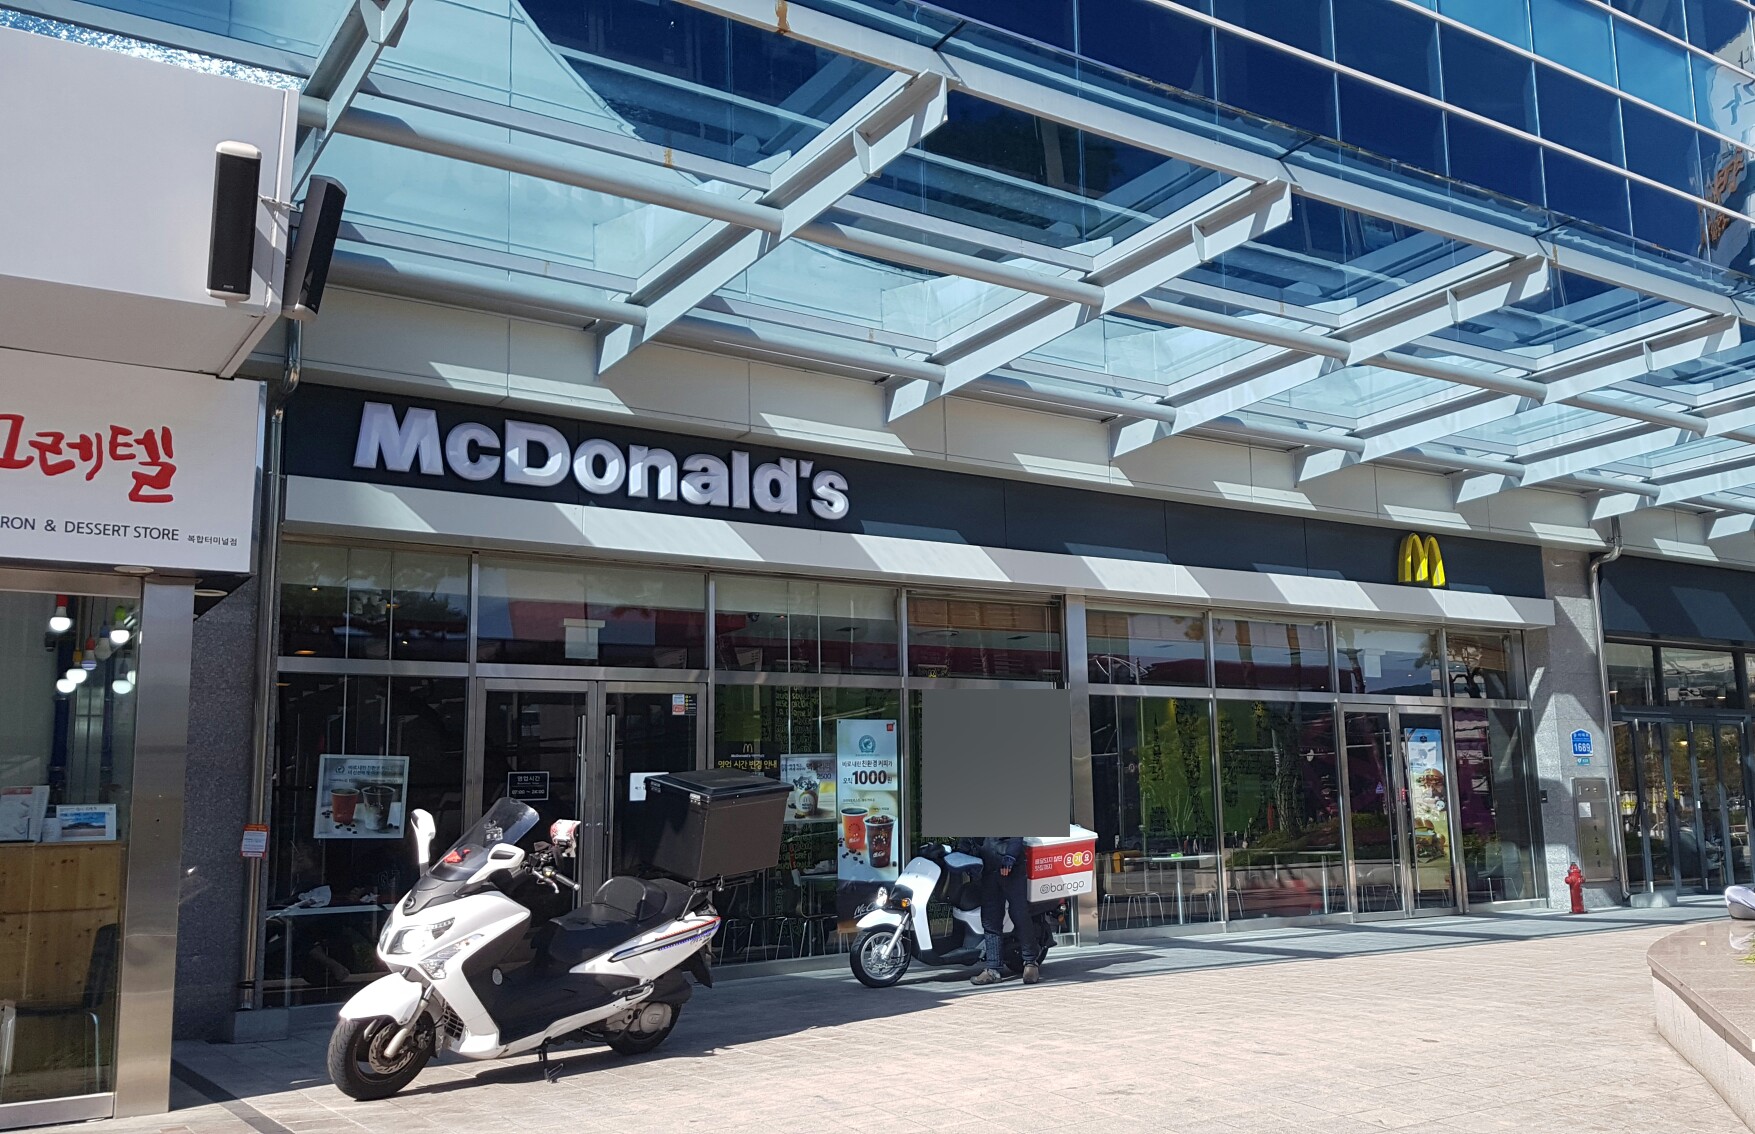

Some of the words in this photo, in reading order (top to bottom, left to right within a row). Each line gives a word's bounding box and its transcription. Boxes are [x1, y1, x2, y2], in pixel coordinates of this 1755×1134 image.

[353, 401, 850, 521] McDonald's
[44, 519, 57, 532] &
[64, 520, 130, 538] DESSERT
[133, 525, 179, 541] STORE
[187, 534, 238, 547] 복합터미널점
[733, 761, 747, 770] 시간
[763, 761, 778, 770] 안내
[862, 760, 877, 768] 친환경
[1065, 852, 1091, 866] 요기요
[1050, 881, 1085, 892] barogo
